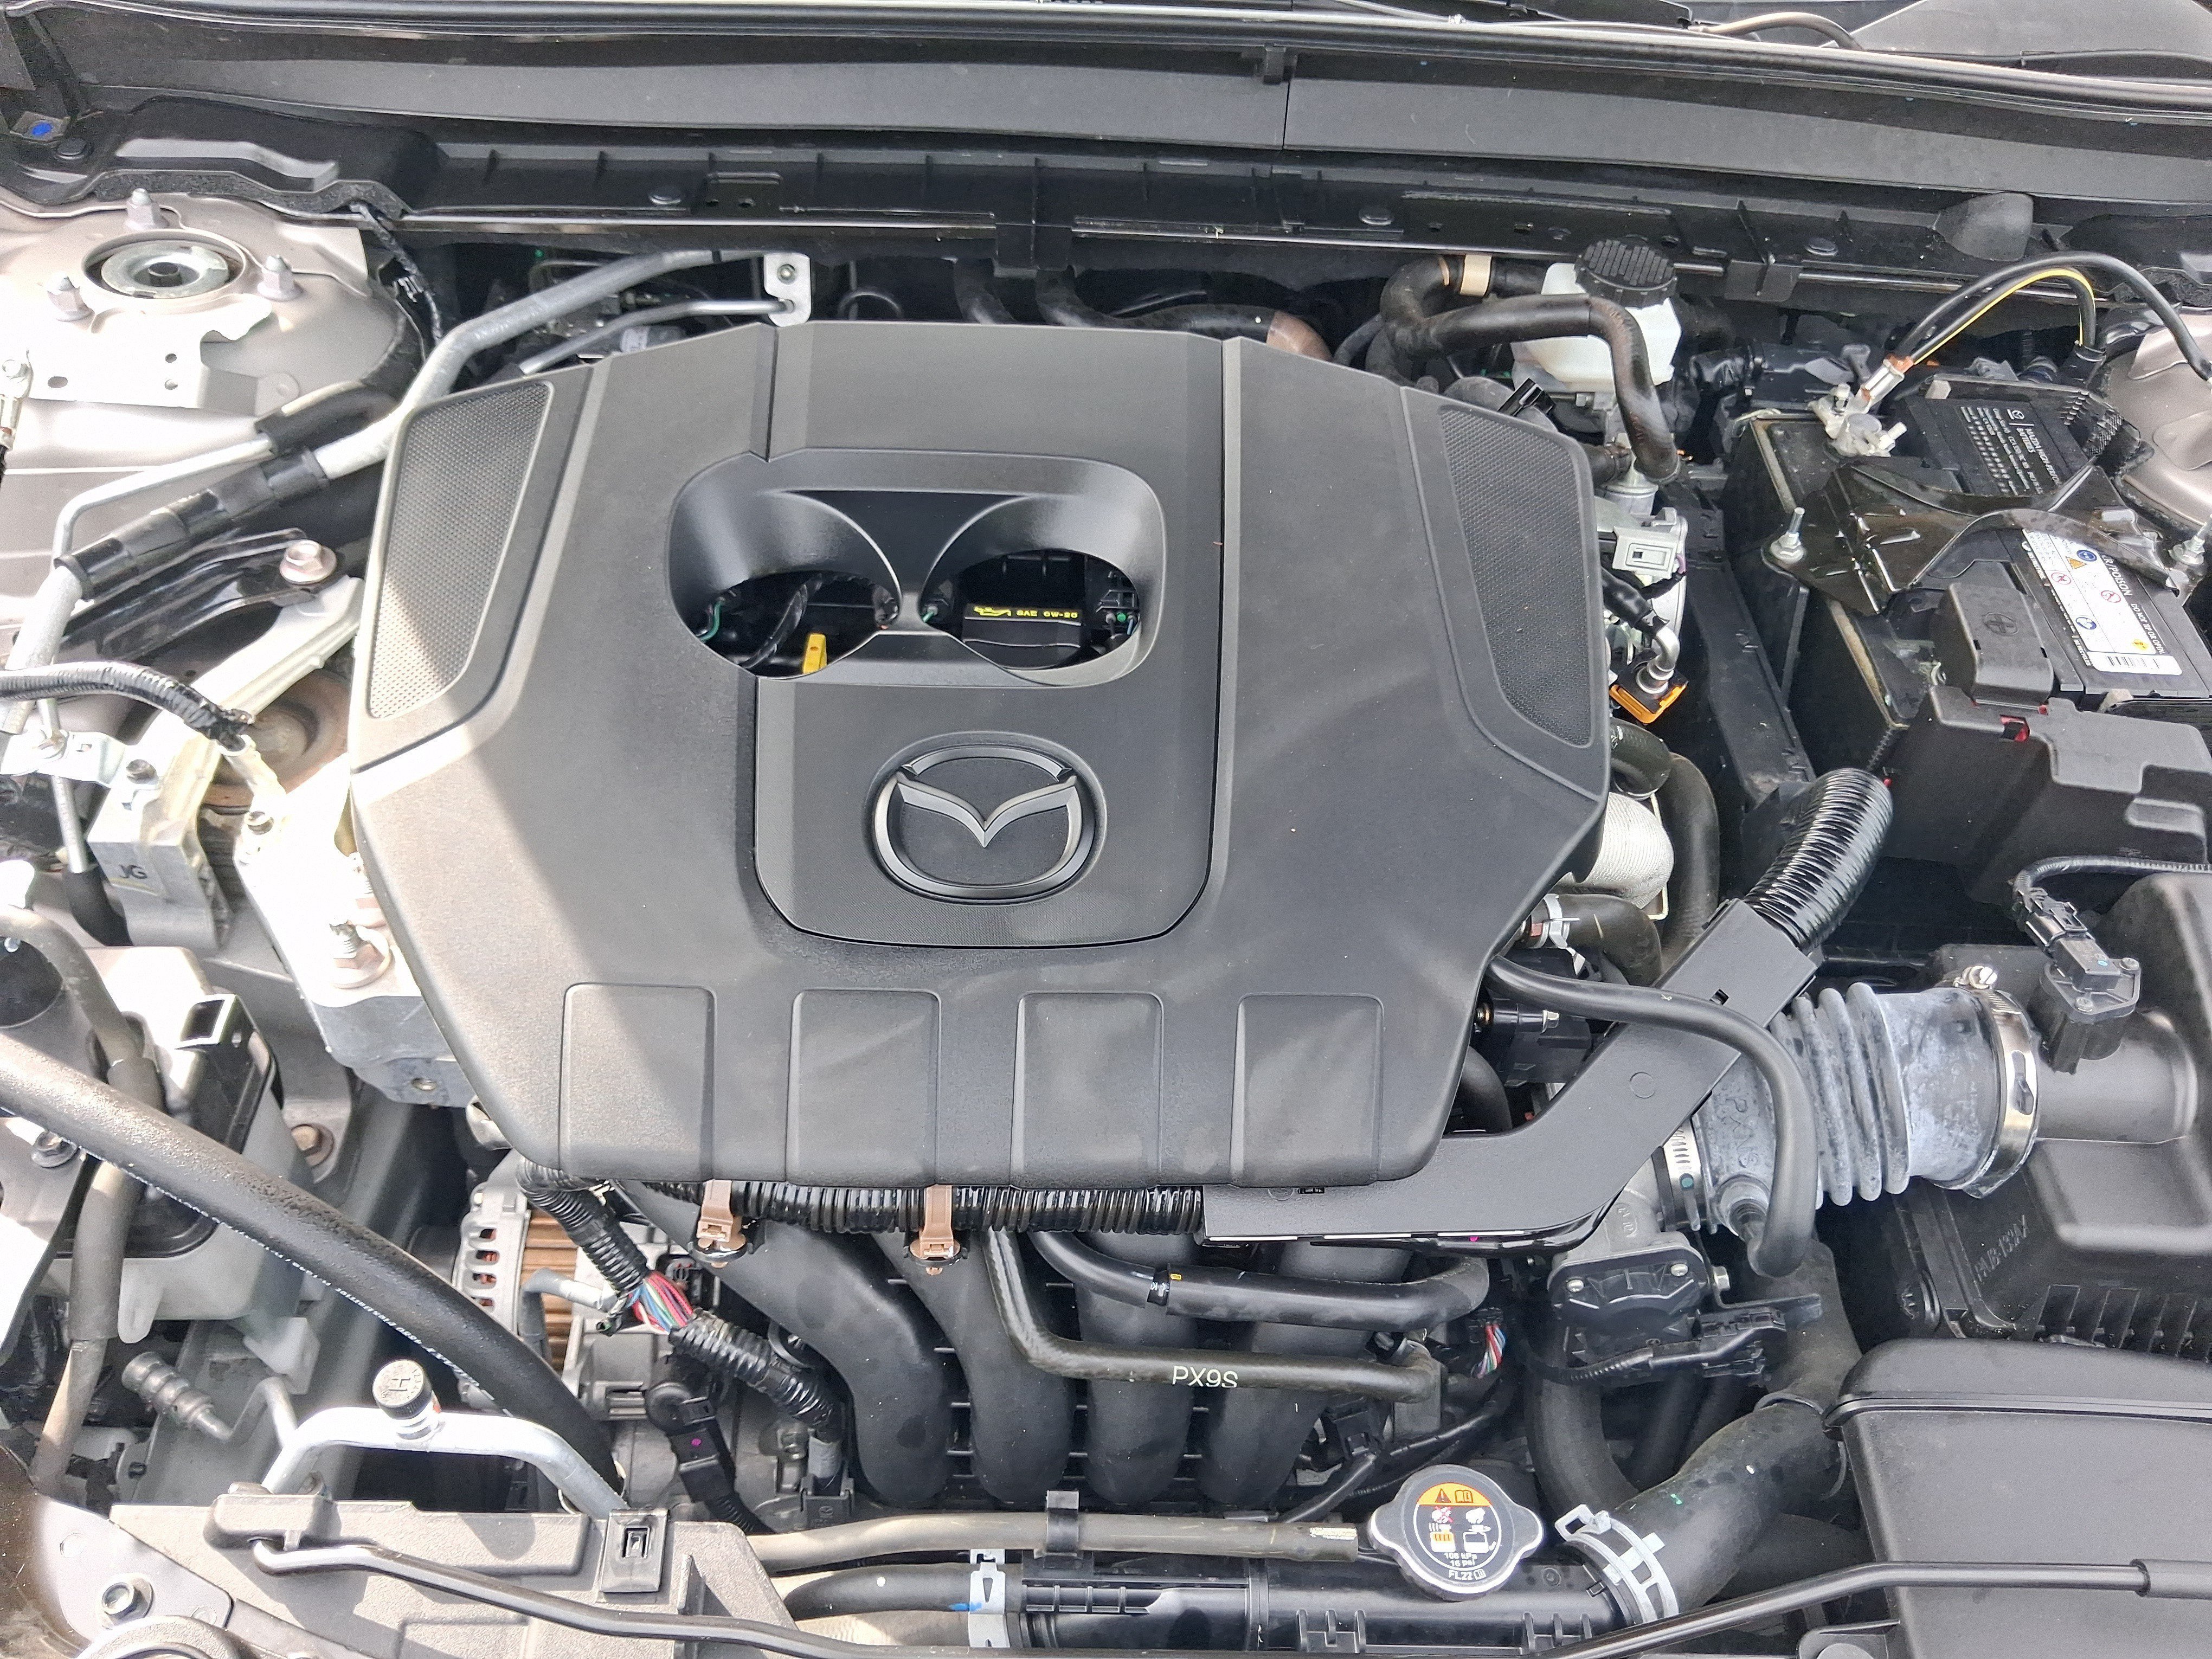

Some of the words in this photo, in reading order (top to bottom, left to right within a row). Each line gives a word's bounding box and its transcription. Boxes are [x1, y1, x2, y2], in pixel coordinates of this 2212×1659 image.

[2025, 428, 2041, 448] MAZDA
[2131, 603, 2140, 612] DO
[2136, 612, 2147, 622] NOT
[1172, 1366, 1238, 1388] PX9S
[1448, 1569, 1473, 1580] FL22
